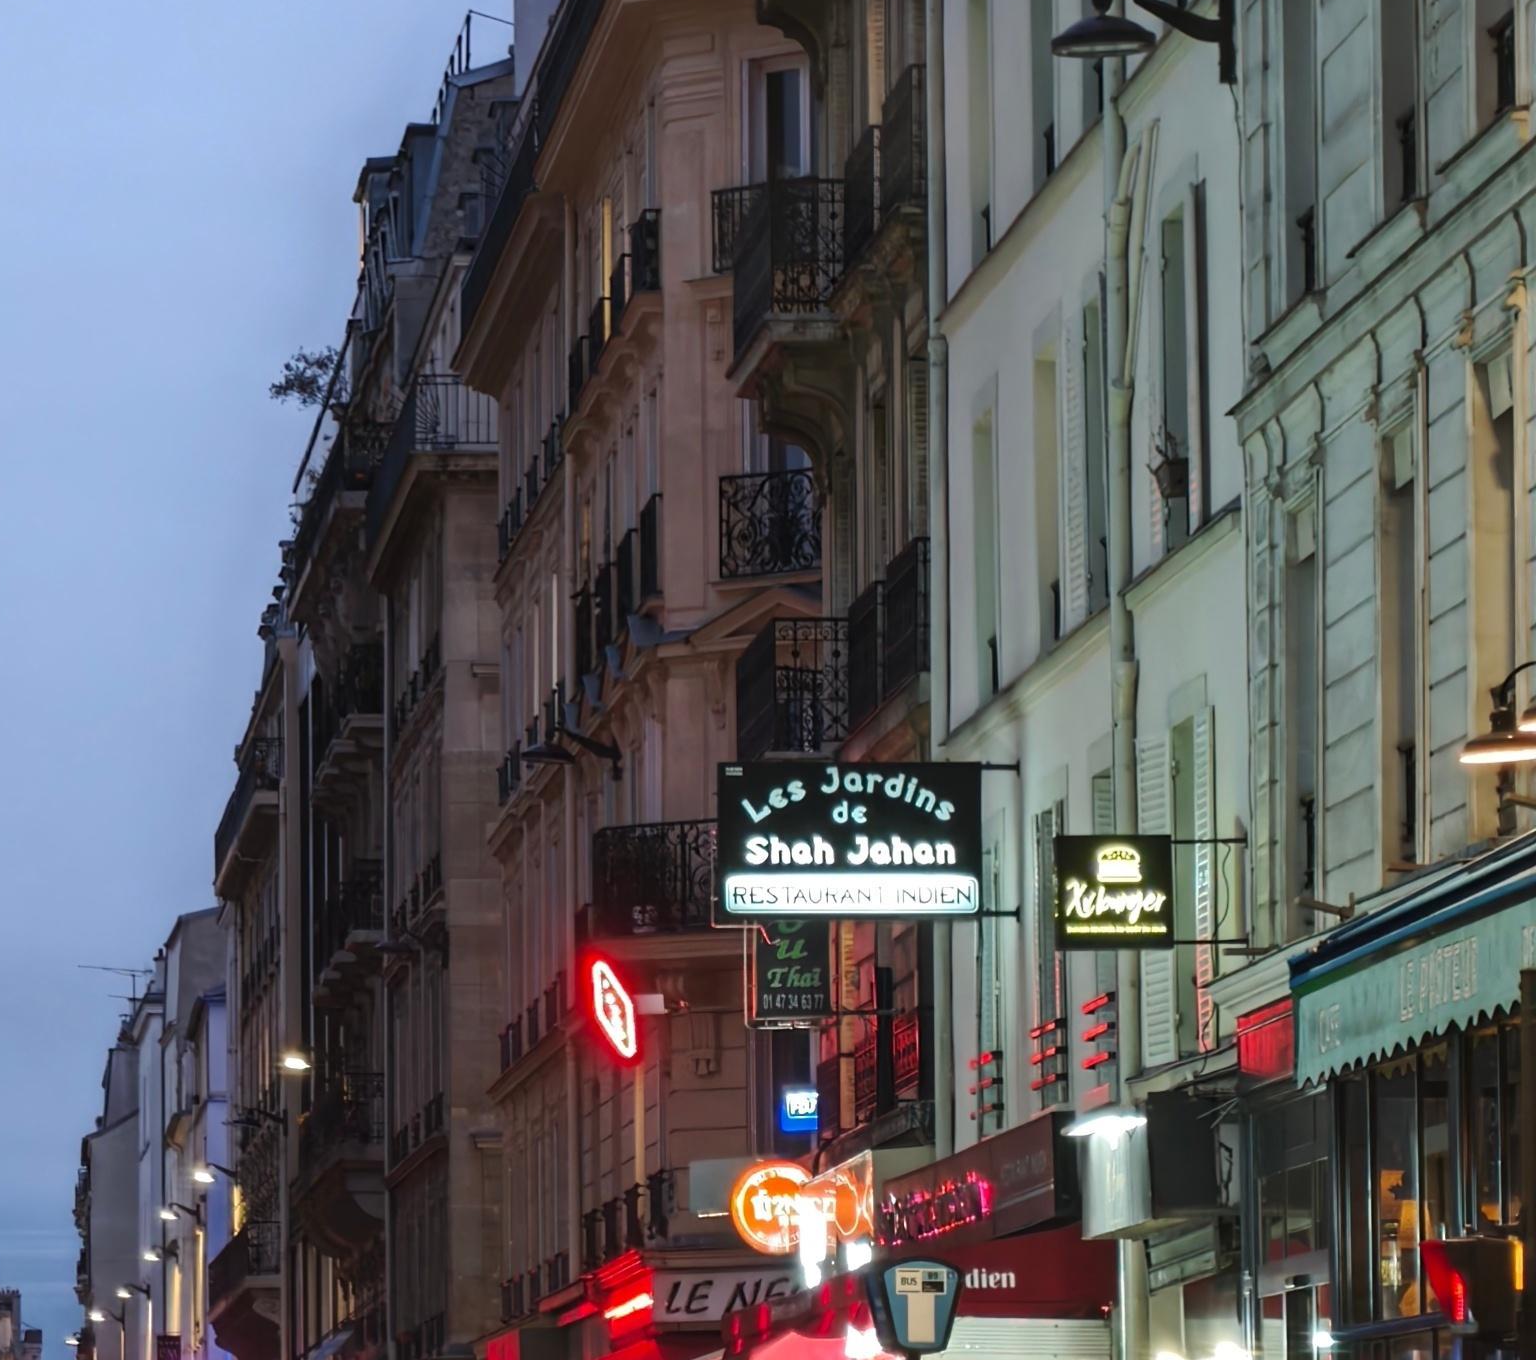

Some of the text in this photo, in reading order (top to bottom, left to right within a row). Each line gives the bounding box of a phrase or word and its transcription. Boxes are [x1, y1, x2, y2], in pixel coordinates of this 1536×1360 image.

[741, 766, 955, 823] Les Jardins
[832, 800, 867, 824] de
[745, 834, 956, 866] Shah Jahan
[733, 886, 972, 905] RESTAURANT INDIEN
[763, 994, 773, 1010] 01
[775, 994, 786, 1009] 47
[900, 1277, 918, 1286] BUS
[965, 1268, 1016, 1289] dien
[665, 1278, 713, 1314] LE
